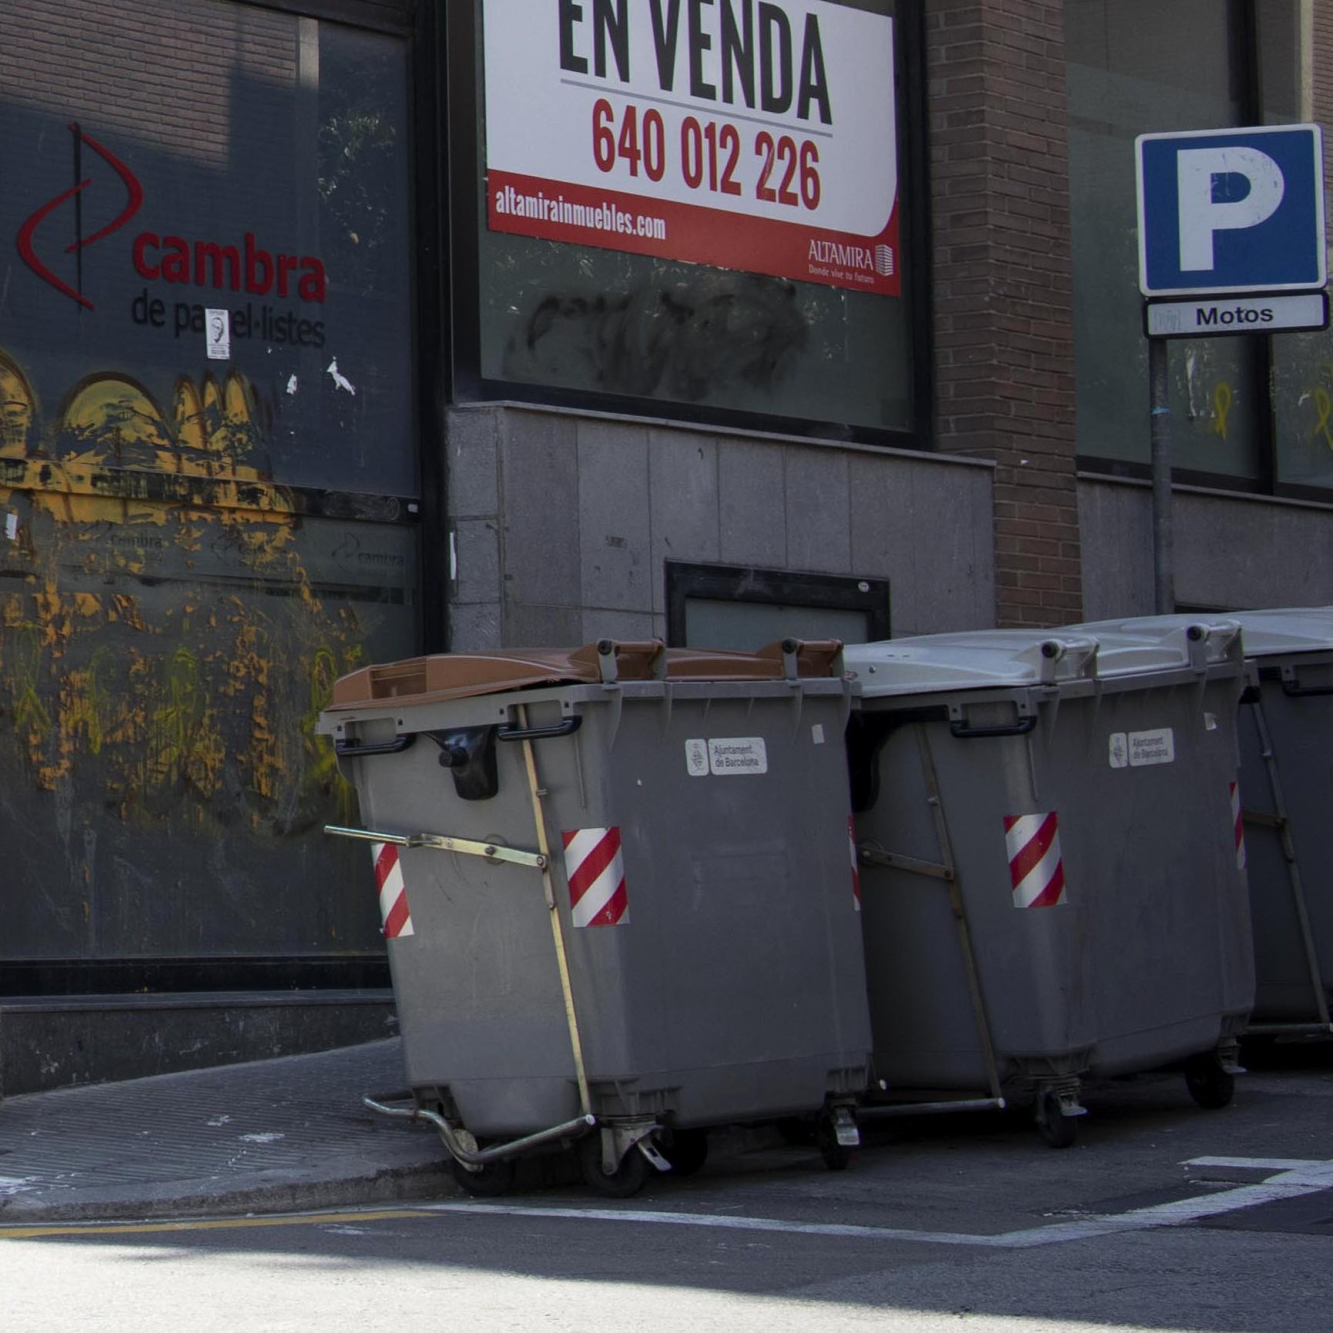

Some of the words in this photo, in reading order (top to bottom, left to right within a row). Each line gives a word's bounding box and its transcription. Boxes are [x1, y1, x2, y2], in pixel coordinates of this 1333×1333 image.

[592, 97, 666, 183] 640
[680, 114, 742, 196] 012
[754, 130, 822, 211] 226
[495, 184, 666, 241] altamirainmuebles.com
[1177, 146, 1285, 272] P
[133, 231, 327, 304] cambra
[808, 238, 875, 271] ALTAMIRA
[131, 286, 166, 328] de
[173, 301, 327, 349] pael·listes
[1195, 306, 1274, 326] Motos
